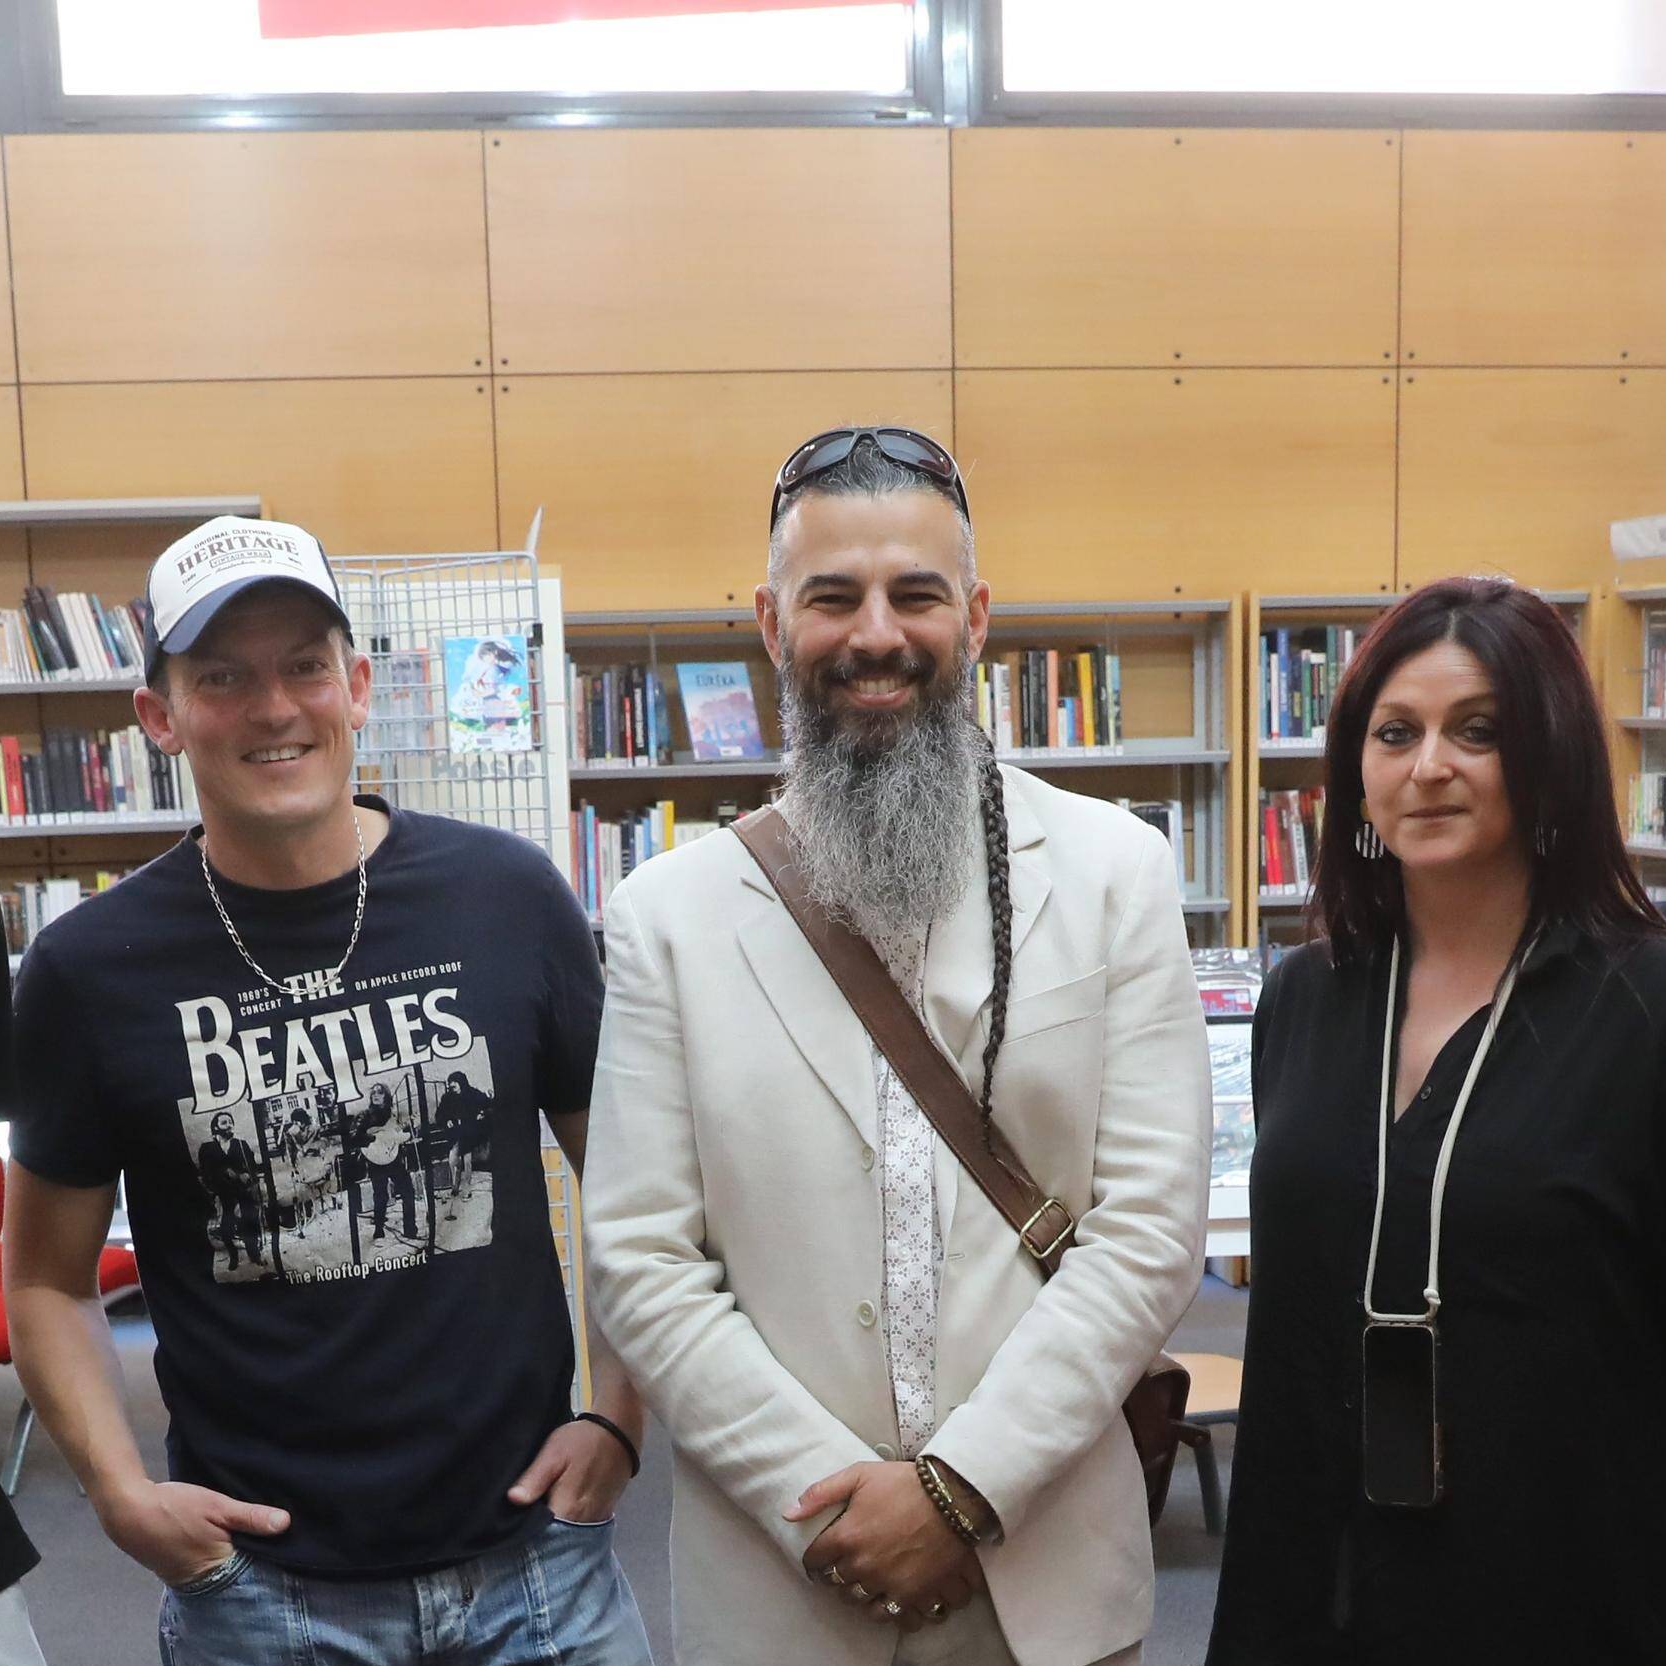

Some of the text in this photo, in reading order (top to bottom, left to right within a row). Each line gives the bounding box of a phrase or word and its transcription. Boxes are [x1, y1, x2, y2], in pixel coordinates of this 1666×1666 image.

[176, 535, 300, 576] HERITAGE
[194, 528, 273, 549] ORIGINAL CLOTHING
[283, 967, 345, 1004] THE
[354, 961, 463, 992] ON APPLE RECORD ROOF
[239, 998, 282, 1017] CONCERT
[173, 986, 474, 1116] BEATLES
[286, 1251, 428, 1285] The Rooftop Concert
